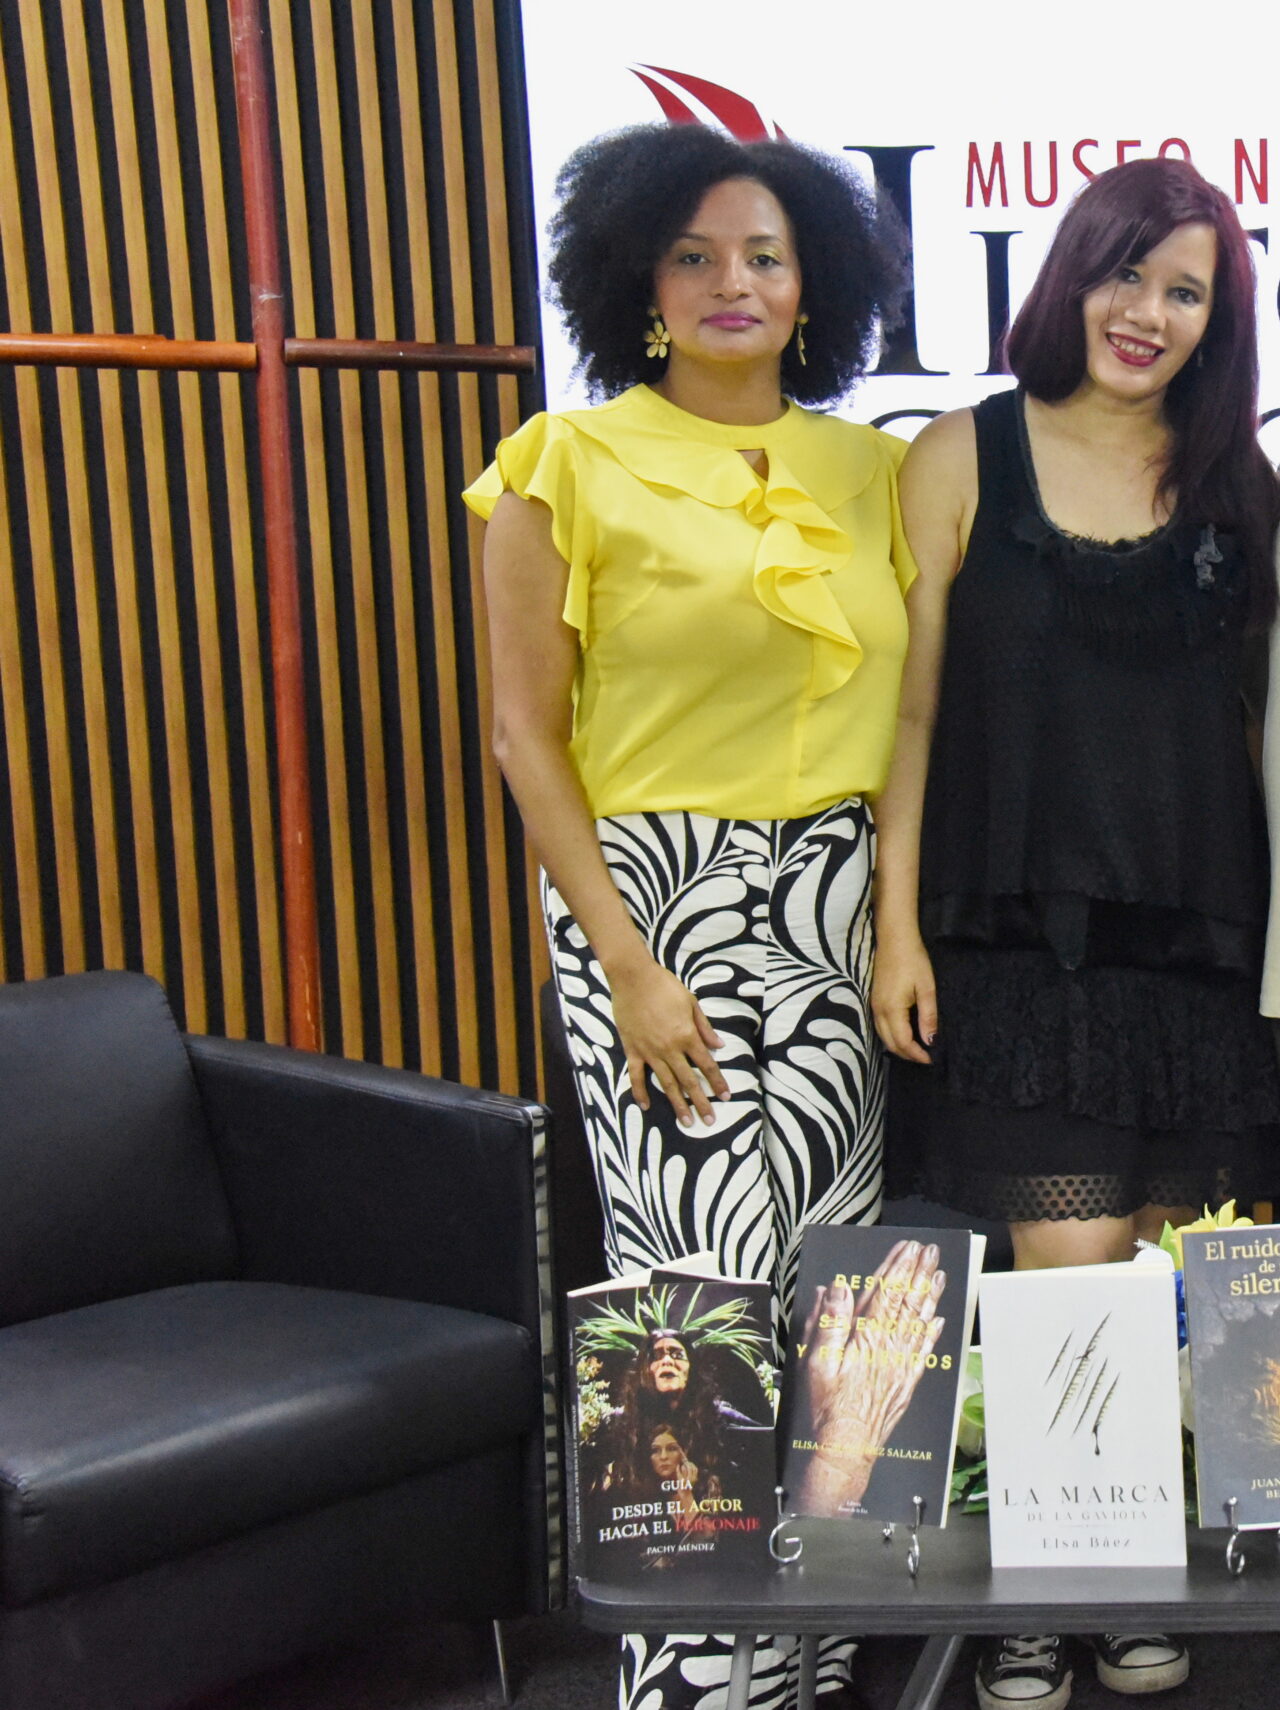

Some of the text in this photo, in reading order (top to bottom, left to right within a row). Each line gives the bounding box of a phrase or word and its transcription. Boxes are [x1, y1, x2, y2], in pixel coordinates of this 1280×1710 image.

[1205, 1241, 1225, 1261] El
[1259, 1259, 1276, 1273] de
[796, 1343, 808, 1359] Y
[792, 1439, 819, 1450] ELISA
[887, 1447, 932, 1461] SALAZAR
[1003, 1485, 1169, 1506] LA MARCA
[612, 1498, 743, 1520] DESDE EL ACTOR
[1027, 1510, 1148, 1522] DE LA GAVIOTA
[599, 1517, 761, 1543] HACIA EL PERSONAJE
[646, 1544, 675, 1555] PACHY
[1043, 1536, 1131, 1549] Elsa Báez
